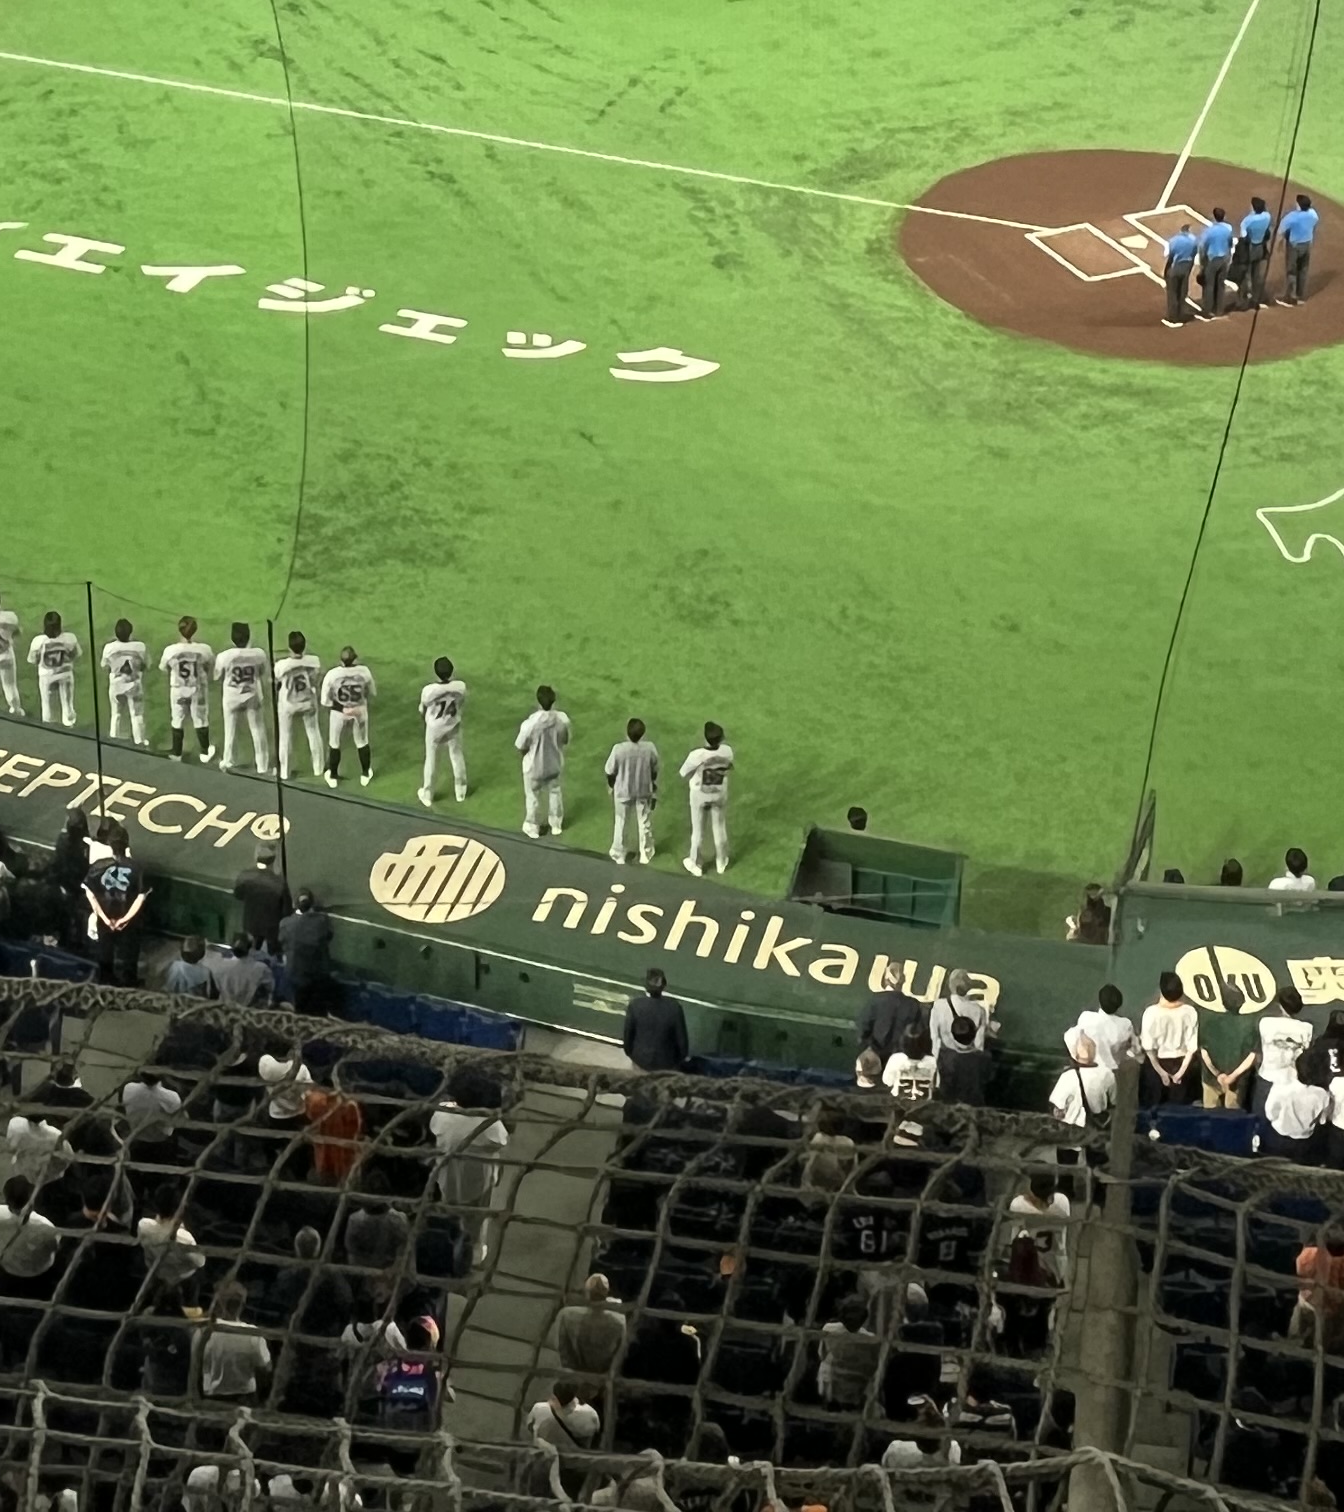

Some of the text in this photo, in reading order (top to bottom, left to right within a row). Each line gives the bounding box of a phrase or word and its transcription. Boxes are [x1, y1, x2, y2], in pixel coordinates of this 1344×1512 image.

[13, 231, 721, 383] エイジェック
[179, 661, 198, 678] 51
[531, 883, 1001, 1010] nishikawa
